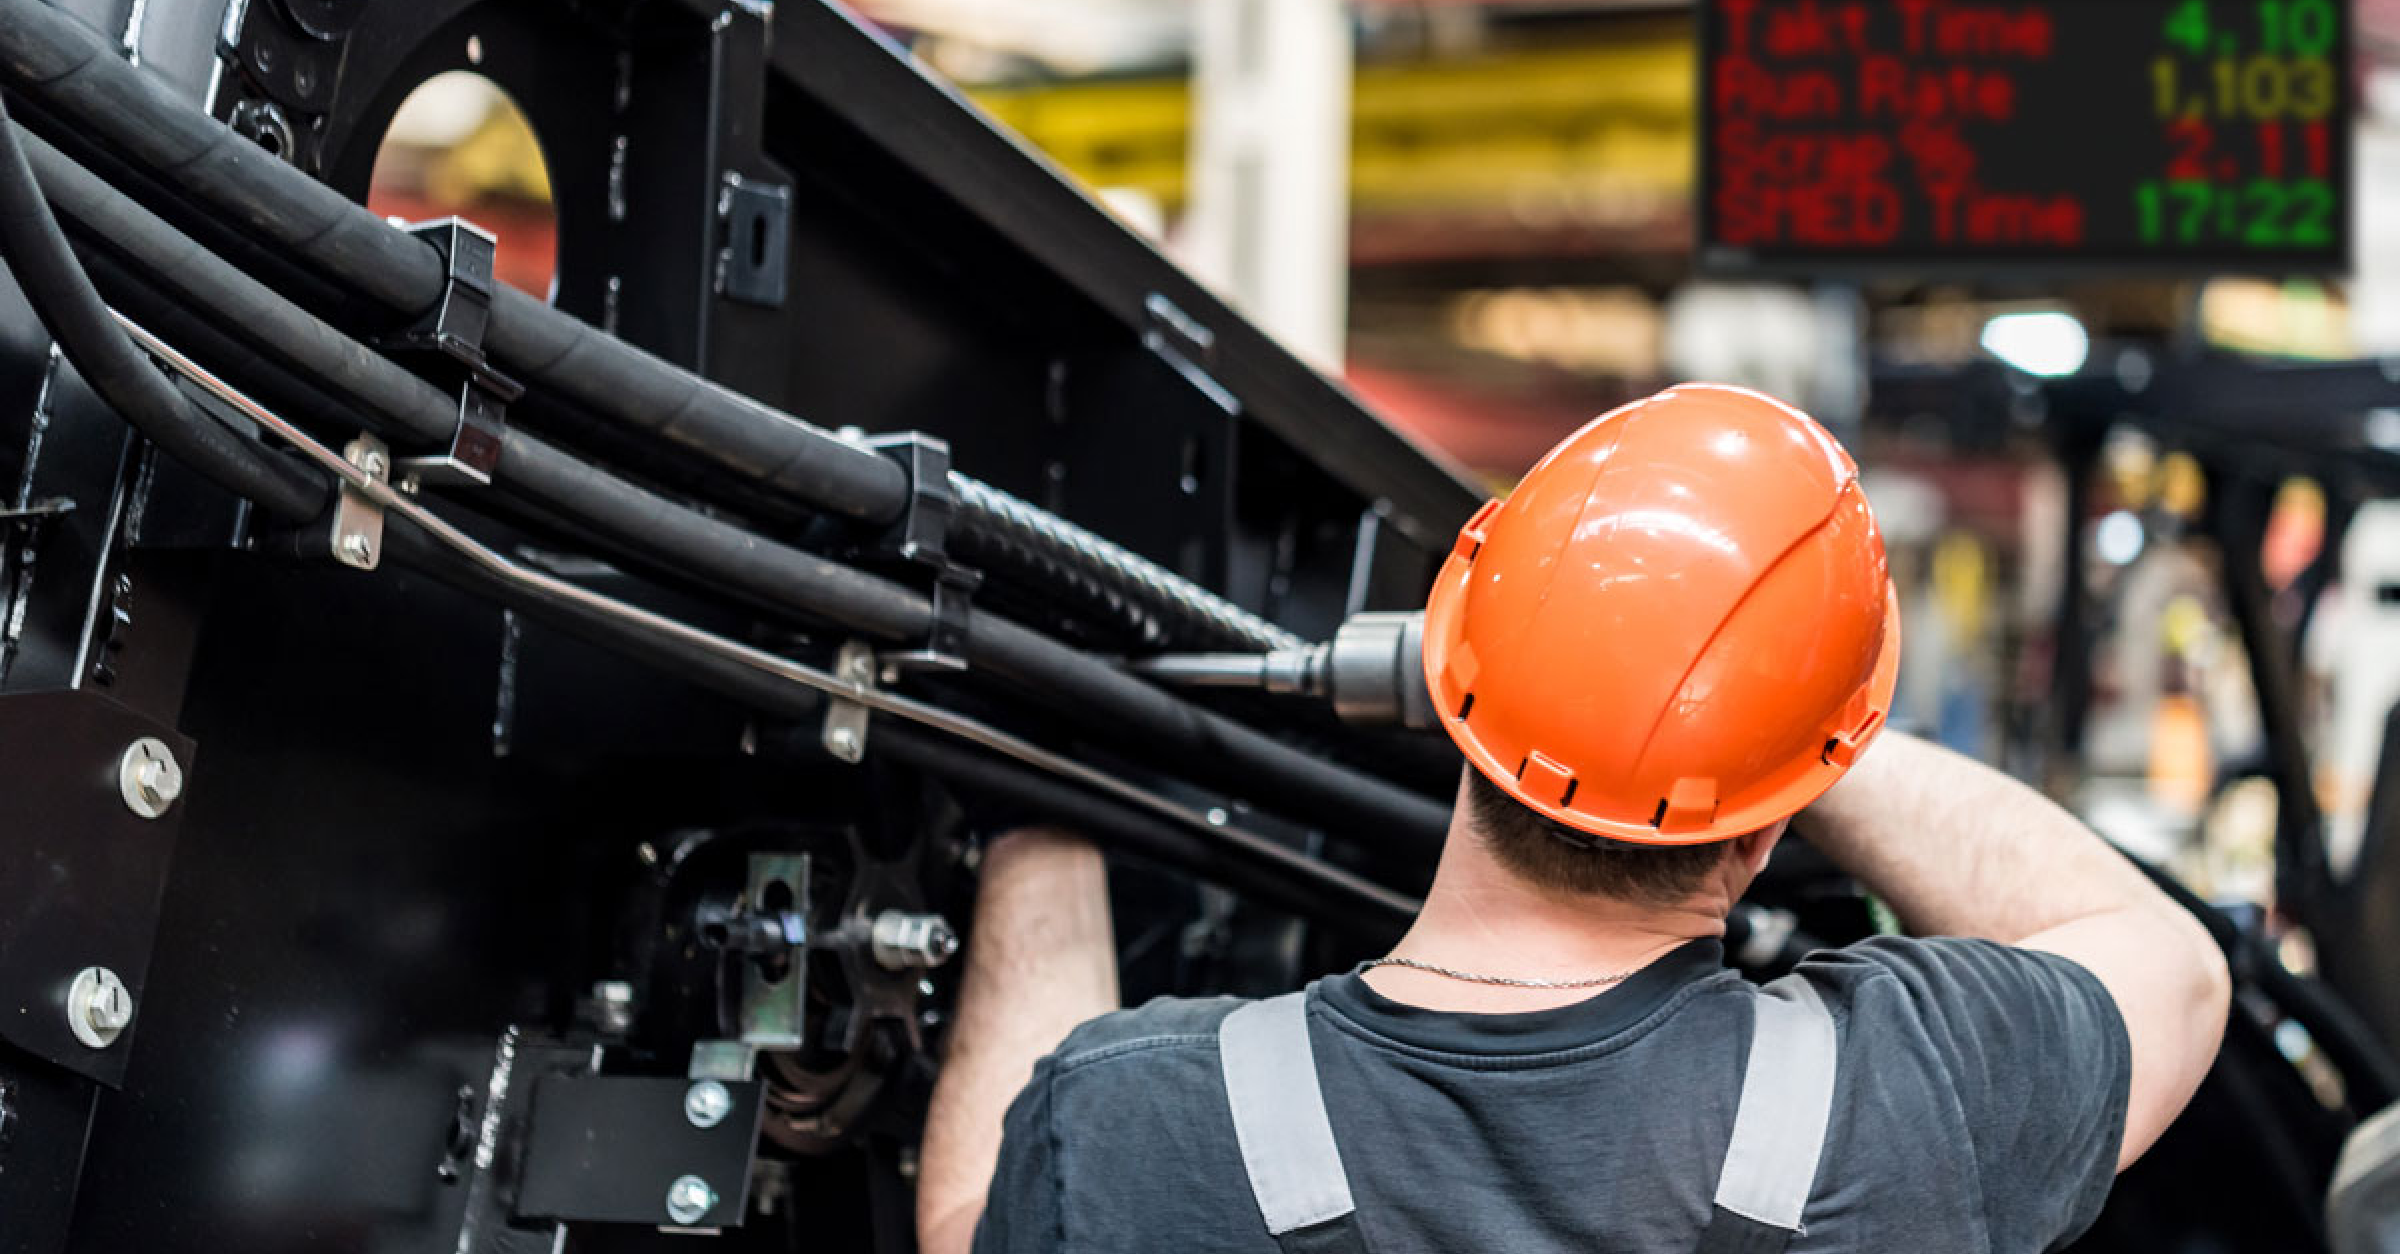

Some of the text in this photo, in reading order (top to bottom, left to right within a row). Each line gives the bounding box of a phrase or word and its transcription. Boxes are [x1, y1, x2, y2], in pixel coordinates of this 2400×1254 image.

[1716, 0, 2334, 56] Takt Time 4.10
[1714, 55, 2334, 118] Run Rate 1,103
[2165, 116, 2330, 180] 2.11
[1715, 180, 2334, 243] SMED Time 17:22
